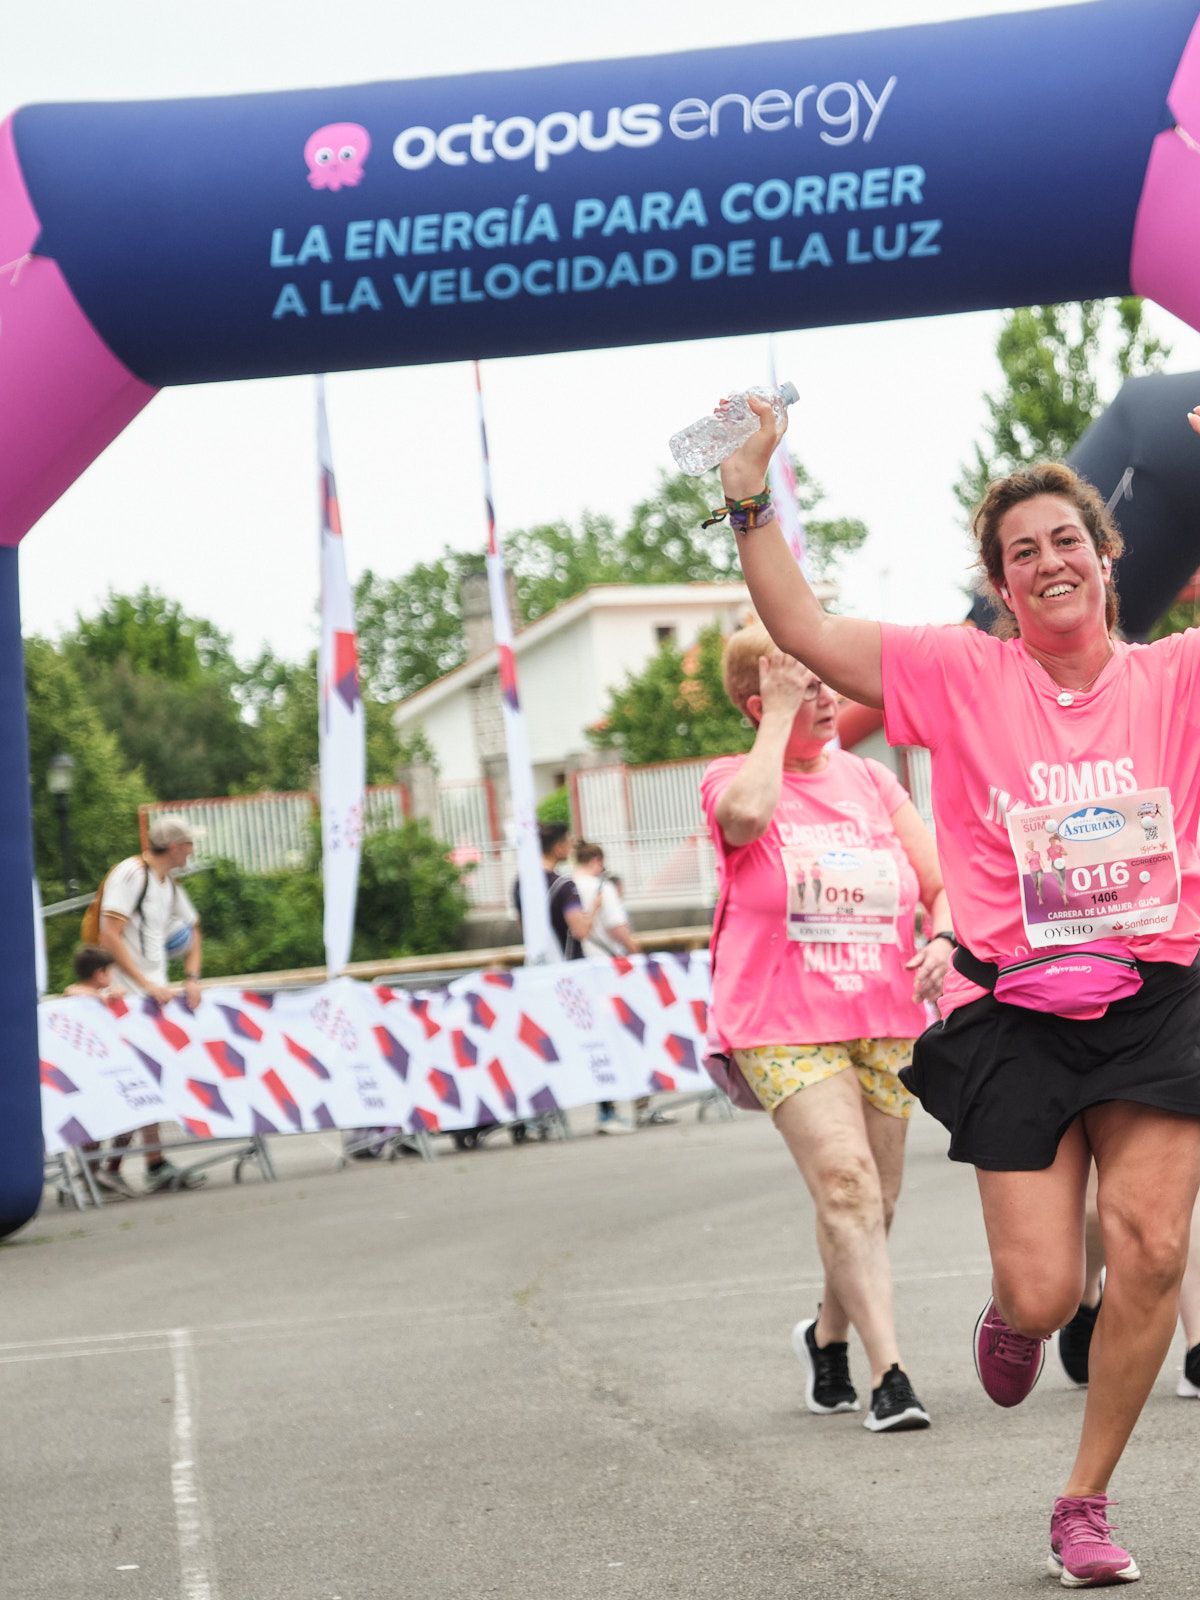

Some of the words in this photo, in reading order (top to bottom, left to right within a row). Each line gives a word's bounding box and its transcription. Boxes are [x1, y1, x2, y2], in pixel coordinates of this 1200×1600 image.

[393, 102, 662, 171] octopus
[668, 75, 898, 146] energy
[270, 225, 331, 267] LA
[344, 194, 559, 261] ENERGÍA
[572, 188, 709, 239] PARA
[720, 164, 926, 222] CORRER
[272, 283, 308, 319] A
[320, 277, 381, 317] LA
[393, 250, 677, 308] VELOCIDAD
[691, 240, 754, 279] DE
[769, 233, 832, 272] LA
[846, 219, 942, 264] LUZ
[1030, 757, 1138, 806] SOMOS
[778, 820, 872, 848] CARRERA
[1023, 820, 1046, 833] SUM
[1071, 861, 1130, 891] 016
[824, 886, 865, 904] 016
[1091, 891, 1118, 905] 1406
[1048, 908, 1083, 920] CARRERA
[1084, 907, 1095, 917] DE
[1096, 905, 1107, 915] LA
[1108, 900, 1133, 913] MUJER
[1044, 925, 1094, 940] OYSHO
[1124, 914, 1169, 930] Santander
[803, 943, 883, 973] MUJER
